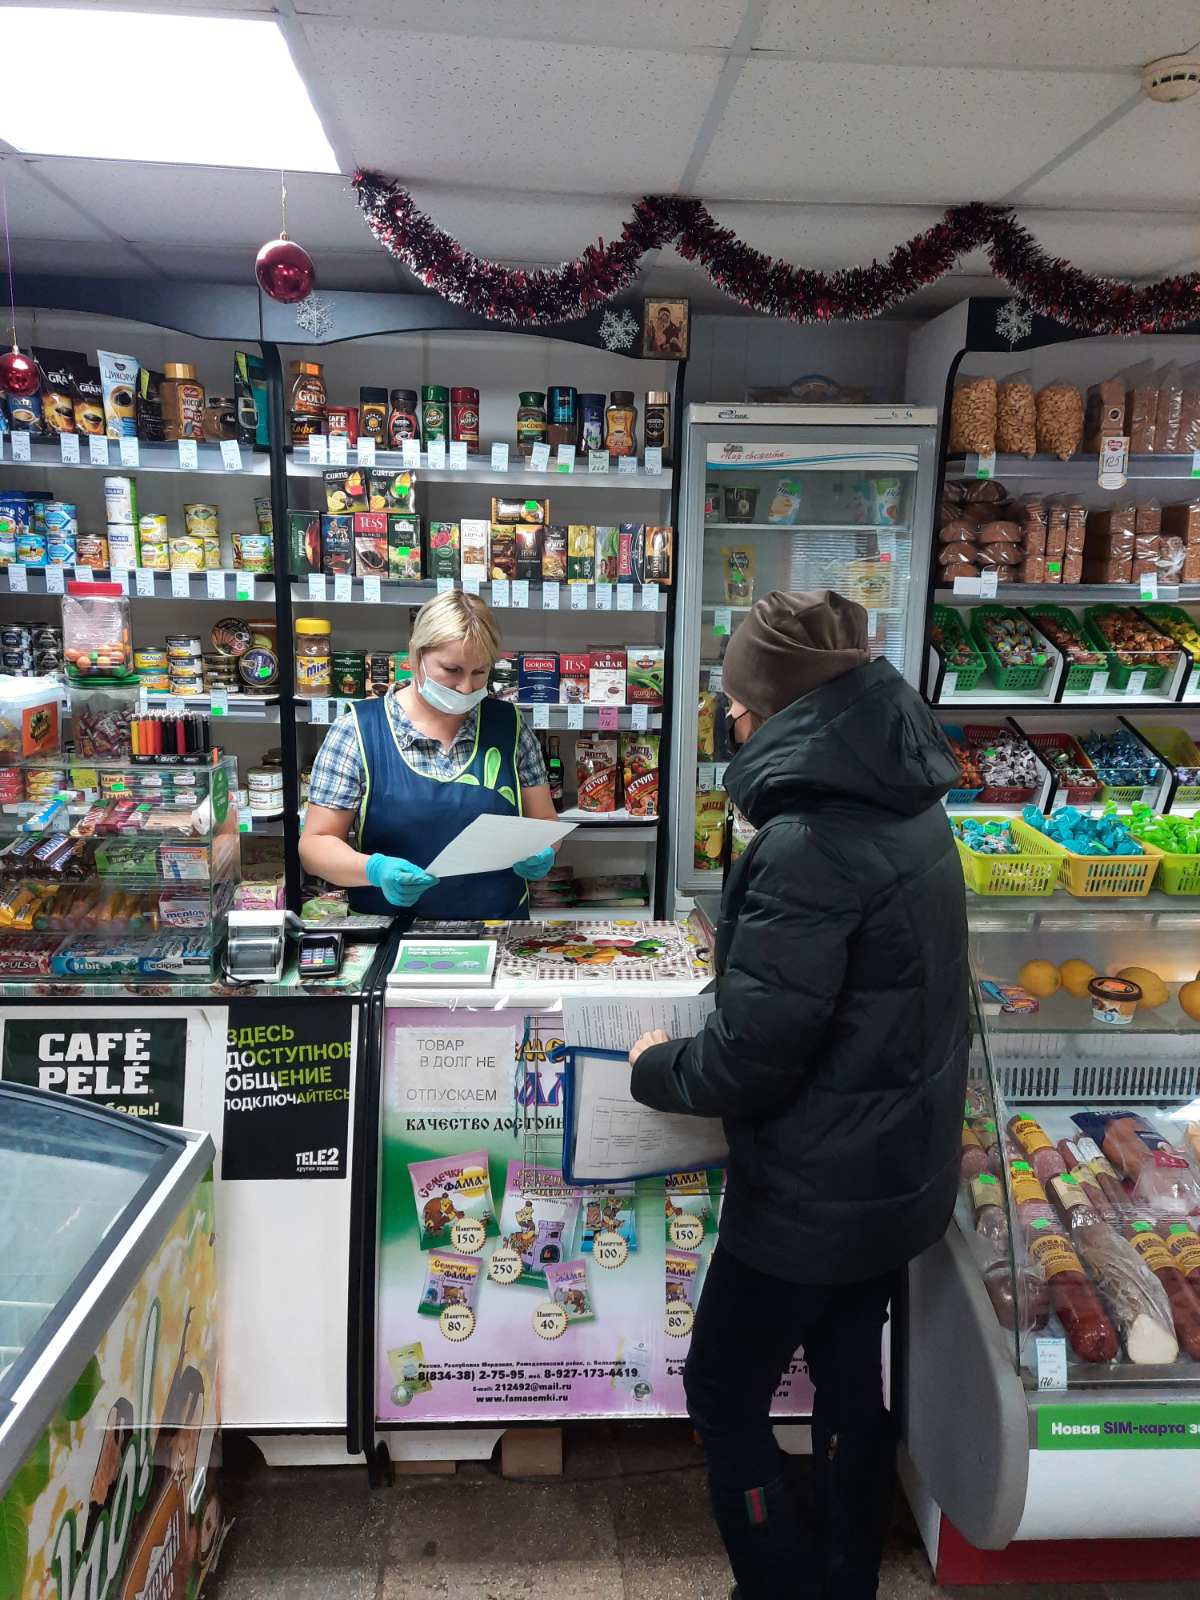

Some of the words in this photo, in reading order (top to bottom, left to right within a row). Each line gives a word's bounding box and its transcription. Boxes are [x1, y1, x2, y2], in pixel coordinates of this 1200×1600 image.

[325, 472, 348, 480] CURTIS
[371, 469, 395, 477] CURTIS
[359, 516, 383, 529] TESS
[593, 660, 622, 668] AKBAR
[227, 1024, 295, 1048] ЗДЕСЬ
[38, 1029, 151, 1062] CAFÉ
[416, 1039, 465, 1051] ТОВАР
[420, 1057, 429, 1068] В
[432, 1056, 473, 1069] ДОЛГ
[477, 1056, 496, 1068] НЕ
[38, 1062, 149, 1095] PELÉ
[225, 1066, 332, 1092] ОБЩЕНИЕ
[406, 1088, 497, 1102] ОТПУСКАЕМ
[406, 1118, 490, 1131] КАЧЕСТВО
[295, 1148, 339, 1166] TELE2
[457, 1234, 475, 1244] 150
[675, 1231, 692, 1240] 150
[600, 1249, 617, 1259] 100
[493, 1264, 512, 1274] 250
[447, 1321, 461, 1331] 80
[540, 1320, 554, 1330] 40
[668, 1318, 682, 1327] 80
[418, 1370, 475, 1381] 8(834-38)
[495, 1383, 572, 1391] 212492@mail.ru
[476, 1394, 569, 1403] www.famasemki.ru
[1051, 1422, 1100, 1435] Новая
[1103, 1421, 1186, 1436] SIM-карта
